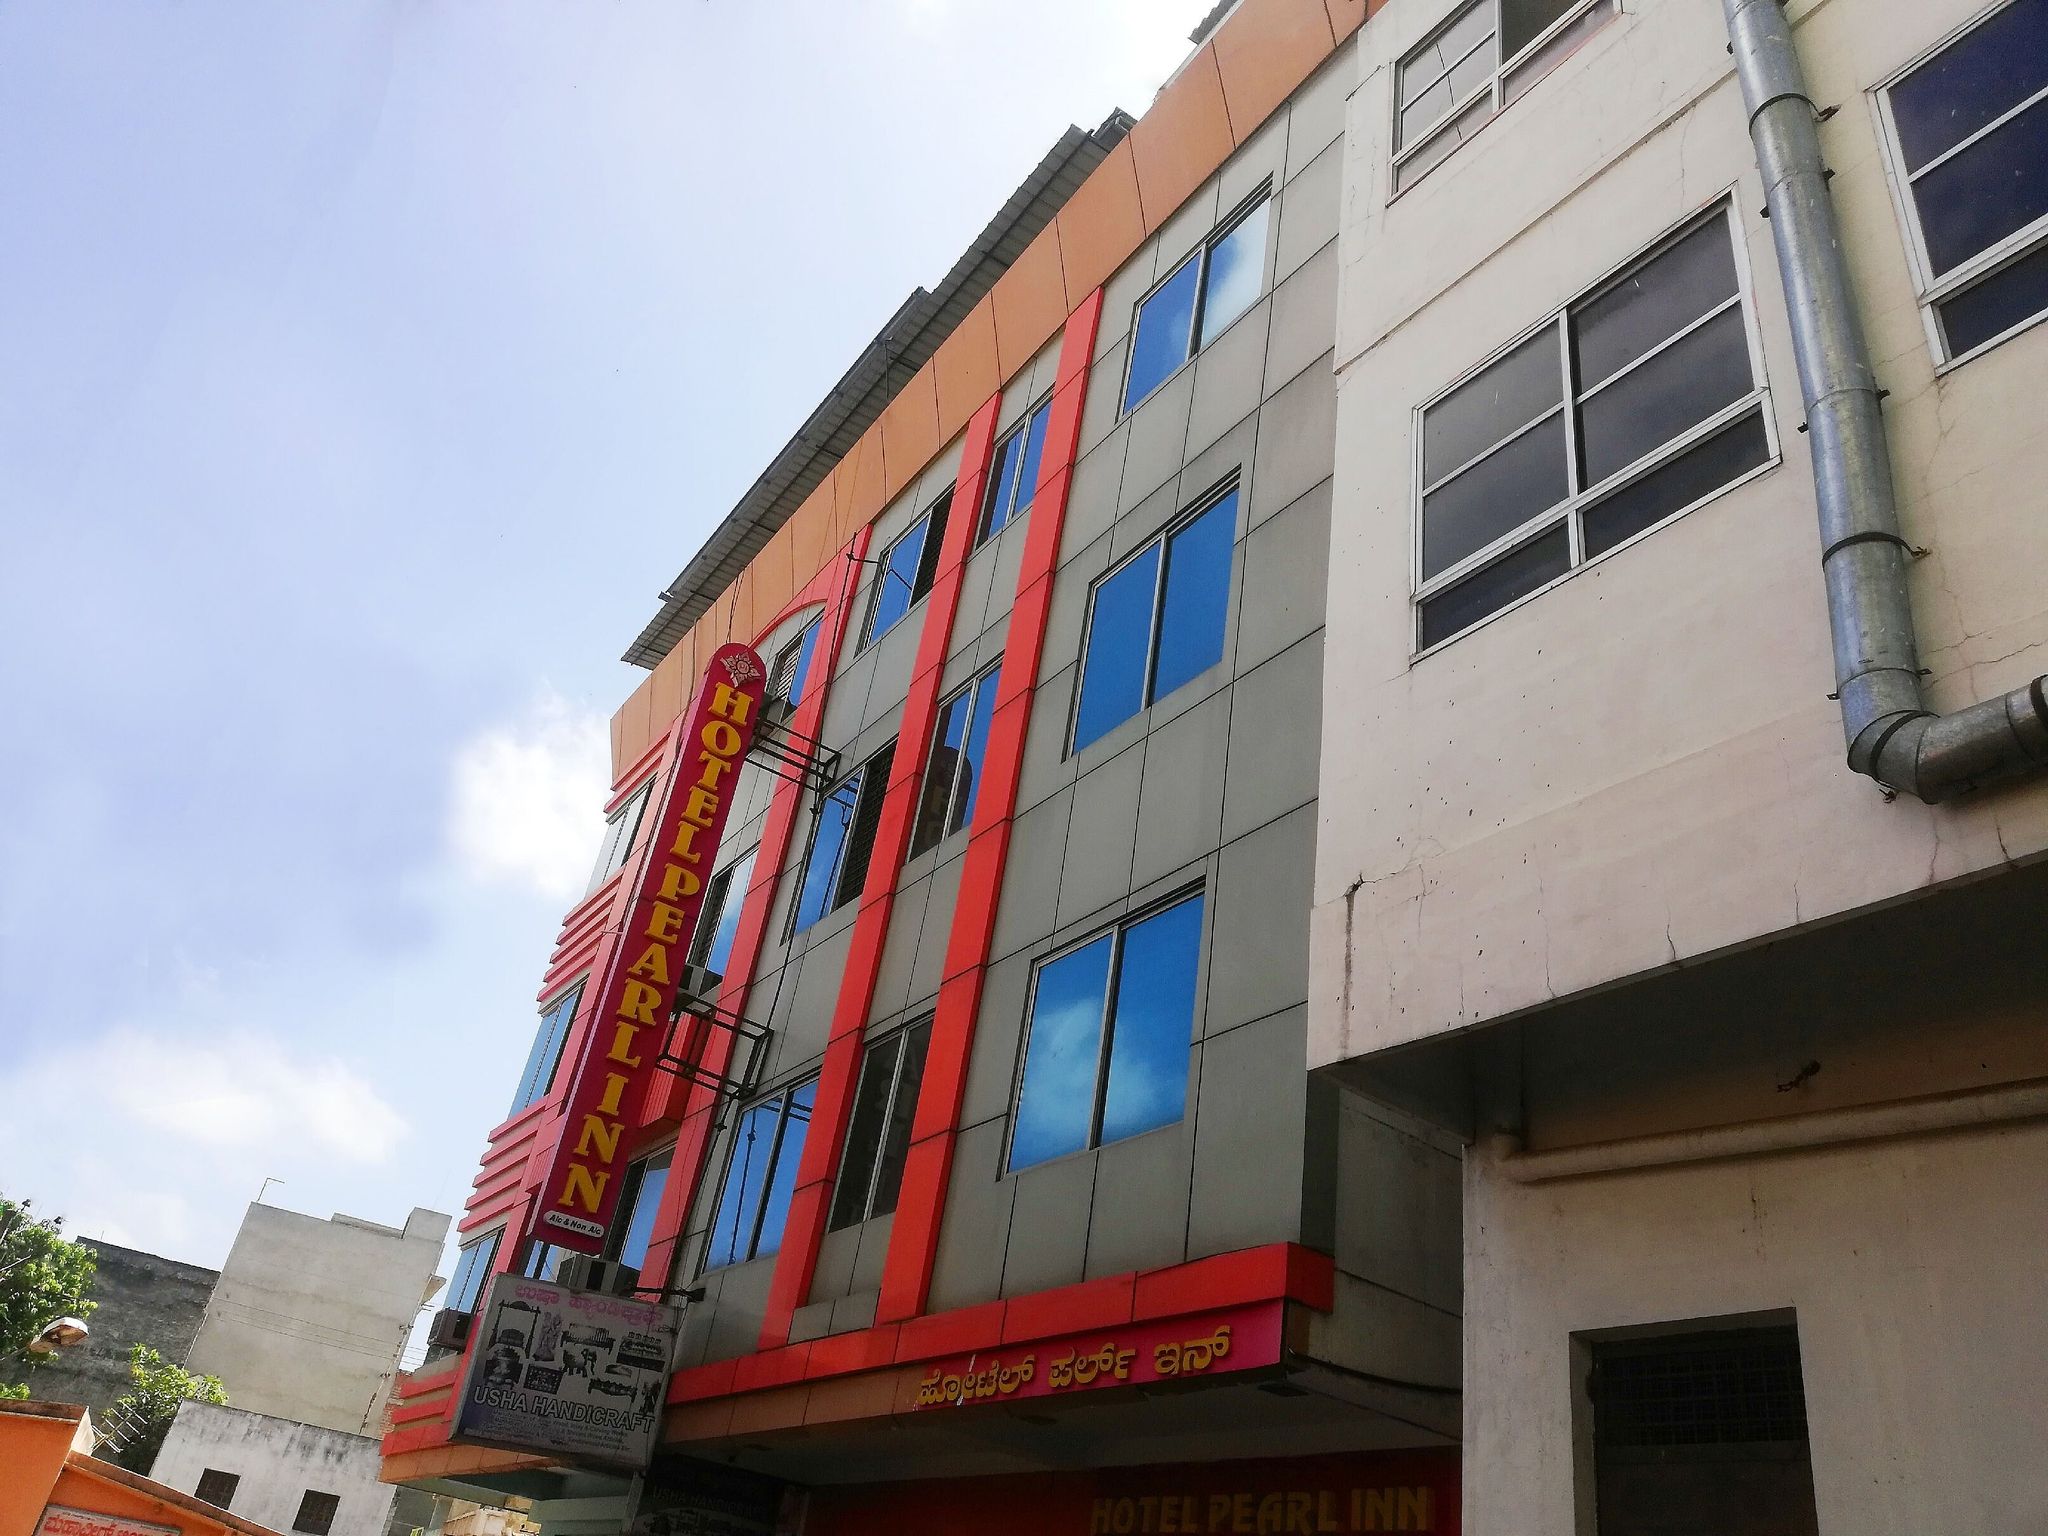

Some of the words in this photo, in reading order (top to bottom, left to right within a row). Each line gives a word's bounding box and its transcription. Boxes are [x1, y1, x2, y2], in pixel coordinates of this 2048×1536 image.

[670, 682, 753, 864] HOTEL
[606, 863, 700, 1069] PEARL
[558, 1072, 629, 1215] INN
[570, 1220, 587, 1231] Non
[1153, 1324, 1231, 1375] ಇನ್
[473, 1386, 528, 1412] USHA
[531, 1395, 656, 1434] HANDICRAFT
[1090, 1495, 1200, 1536] HOTEL
[1207, 1489, 1338, 1536] PEARL
[1350, 1486, 1432, 1532] INN
